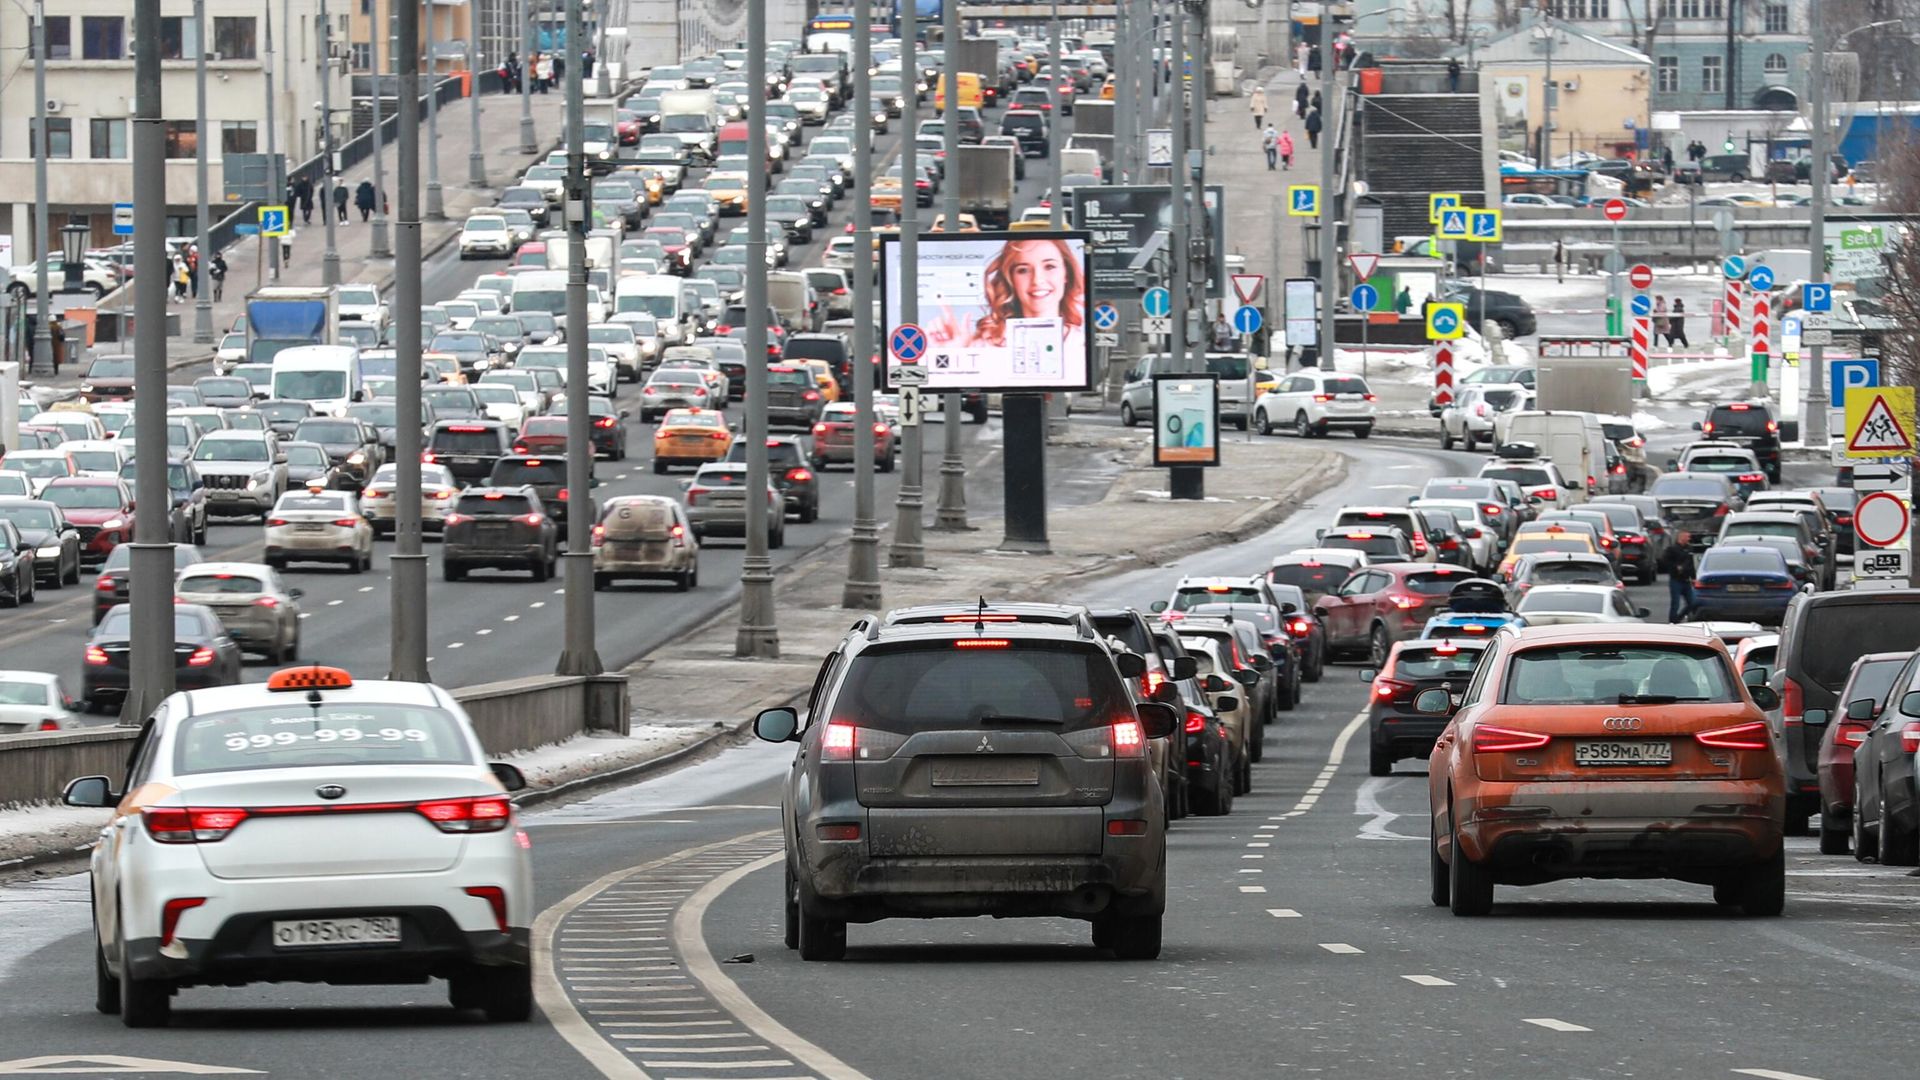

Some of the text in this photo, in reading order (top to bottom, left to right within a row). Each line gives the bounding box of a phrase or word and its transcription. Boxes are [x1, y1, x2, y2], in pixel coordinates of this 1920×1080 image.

[1810, 287, 1826, 308] P
[1785, 321, 1797, 334] P
[1808, 318, 1820, 326] 50
[1878, 557, 1892, 565] 2,5
[226, 728, 427, 752] 999-99-99
